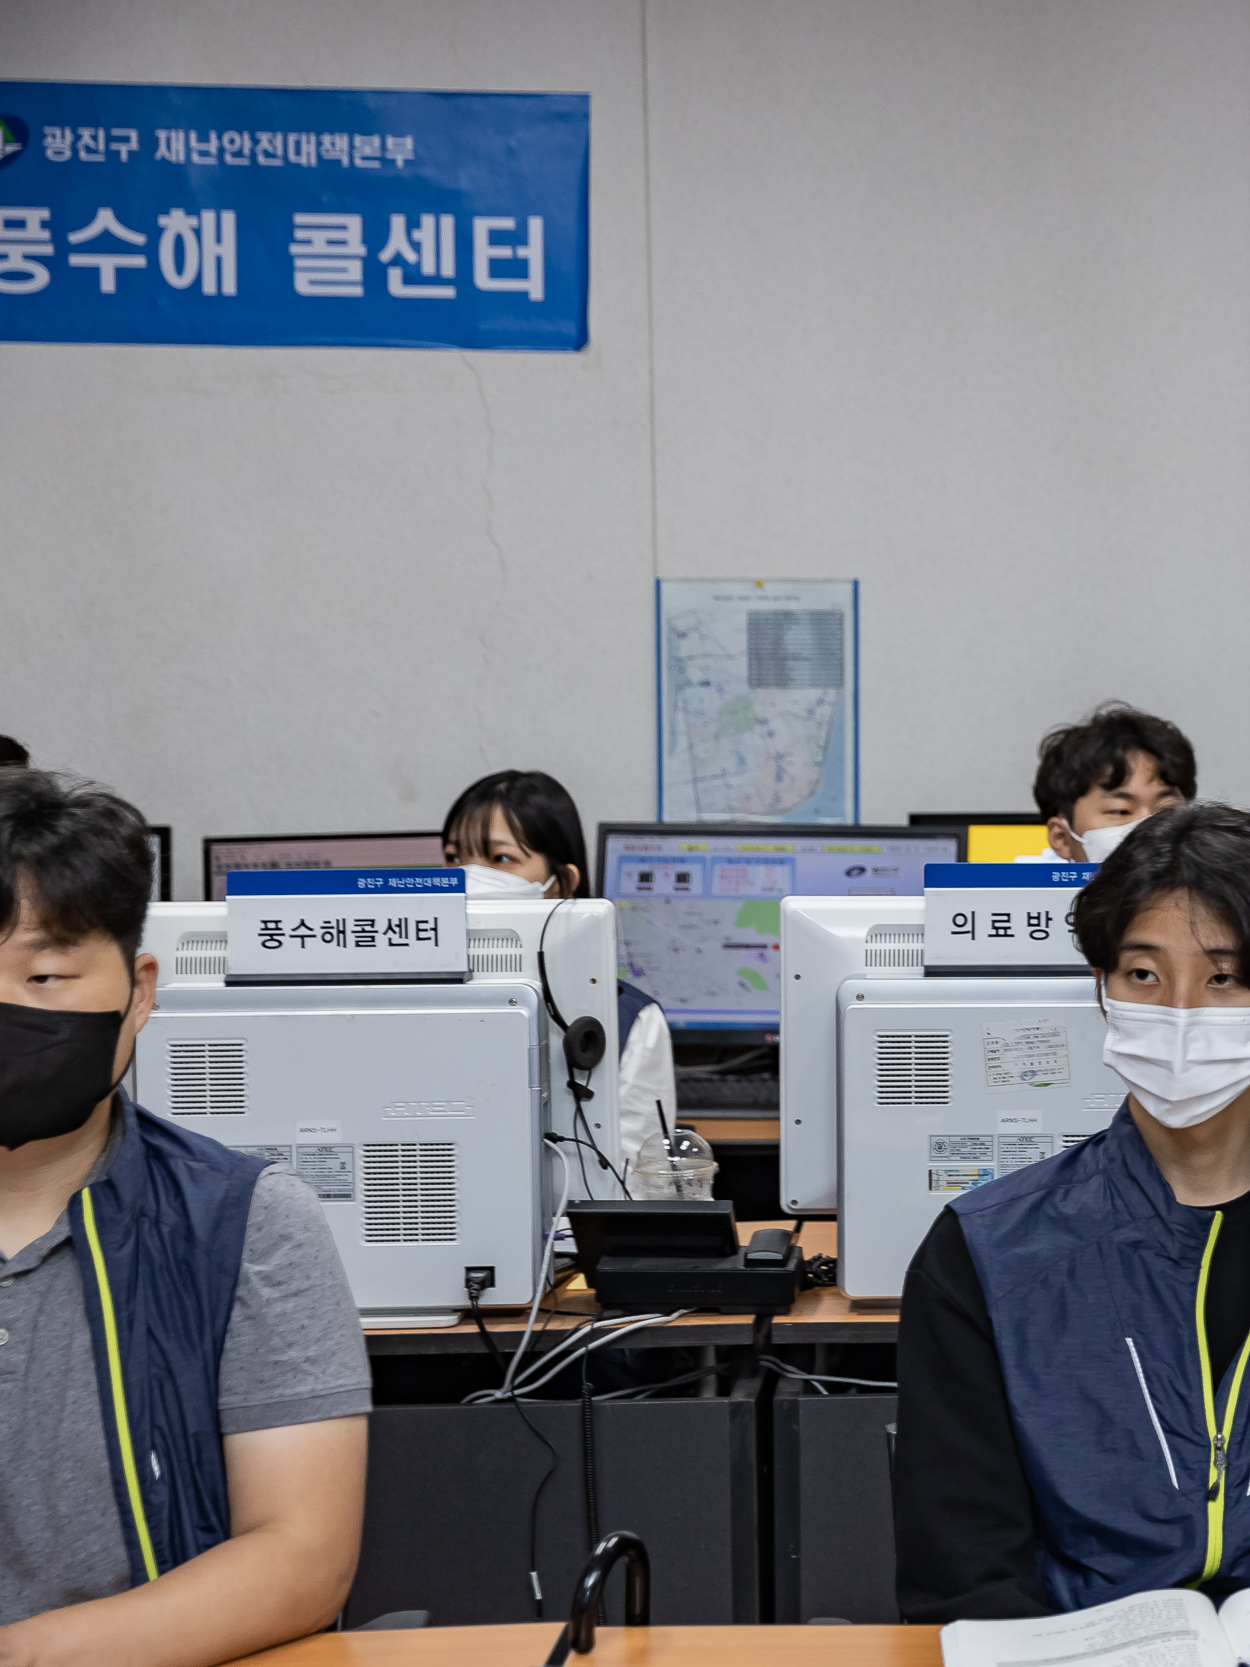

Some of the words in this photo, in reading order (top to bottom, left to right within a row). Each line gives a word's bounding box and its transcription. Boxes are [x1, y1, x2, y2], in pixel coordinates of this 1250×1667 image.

[42, 125, 140, 164] 광진구
[154, 128, 416, 169] 재난안전대책본부
[0, 206, 238, 297] 풍수해
[288, 210, 547, 303] 콜센터
[356, 877, 384, 889] 광진구
[387, 876, 459, 888] 재난안전대책본부
[1051, 871, 1079, 882] 광진구
[257, 916, 441, 950] 풍수해콜센터
